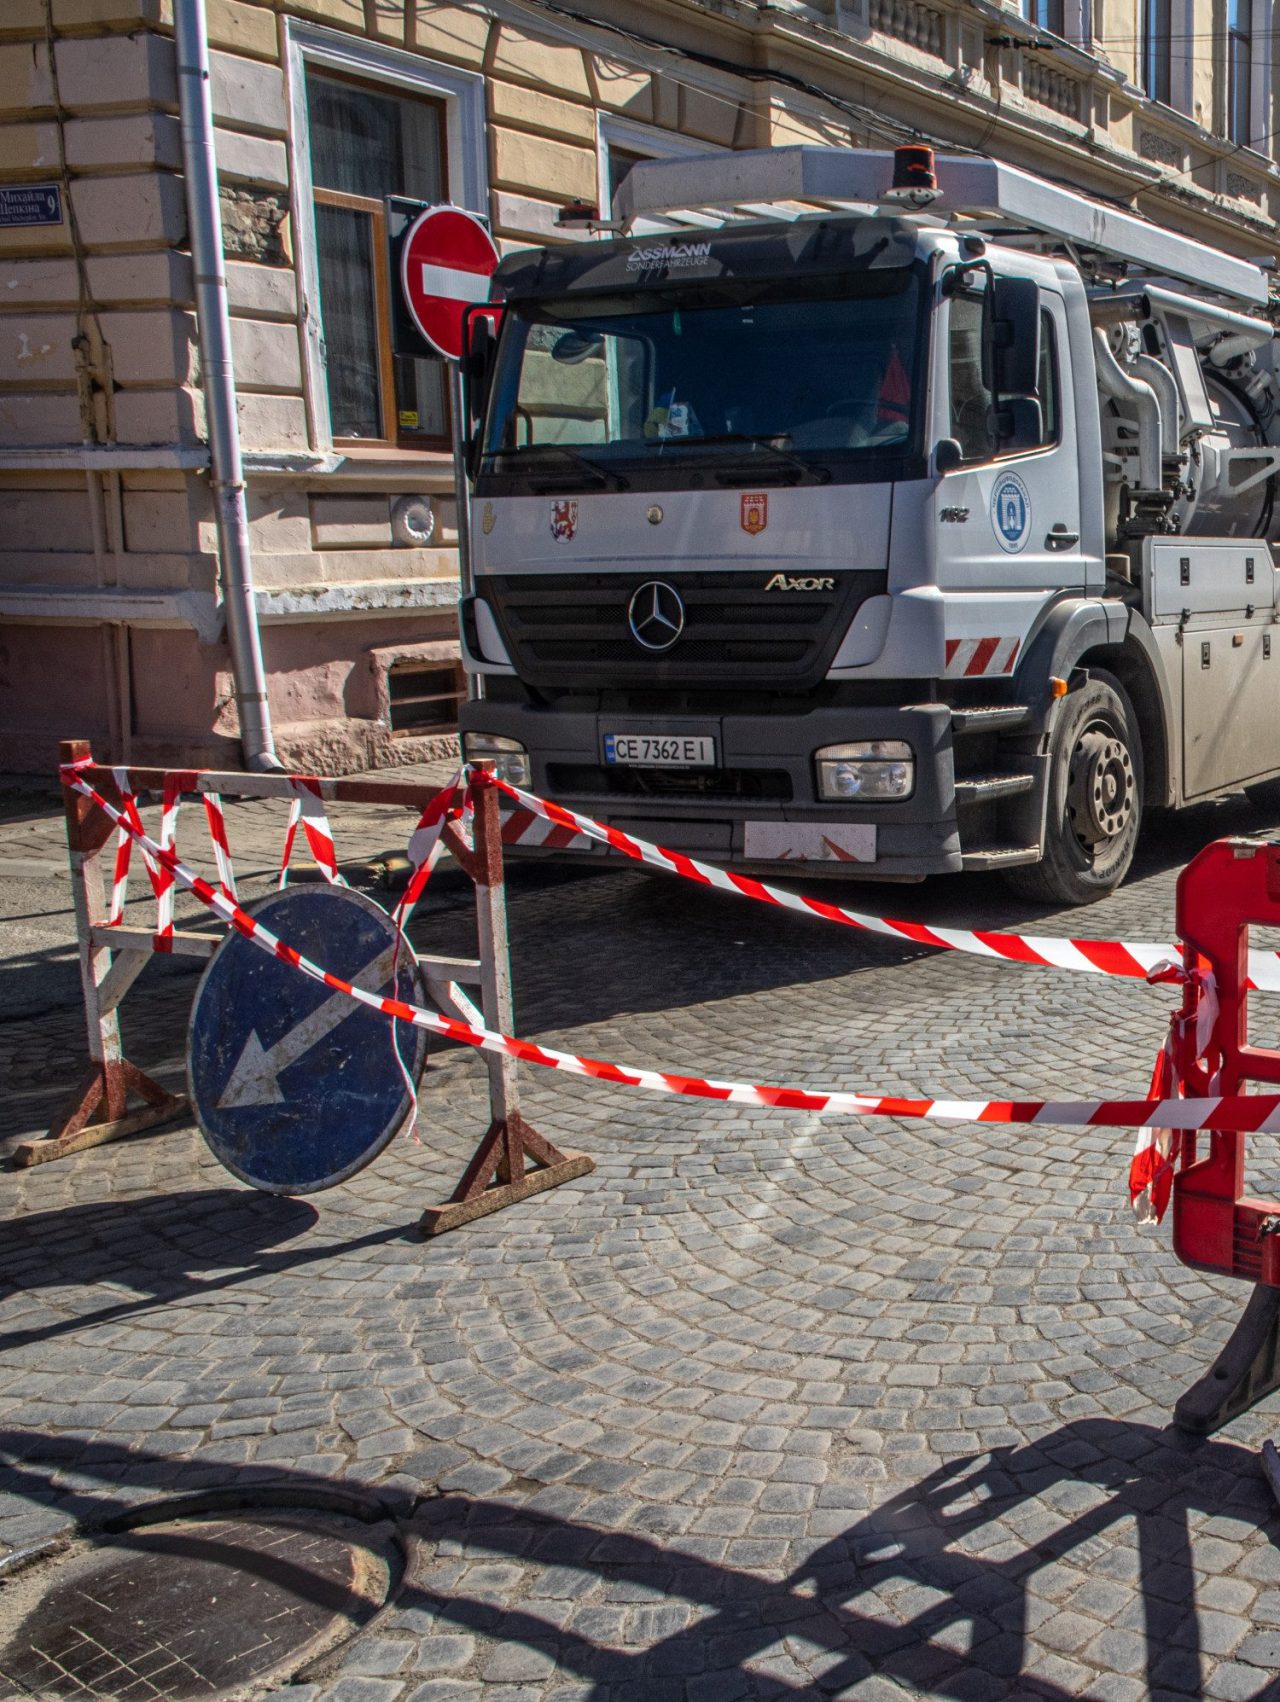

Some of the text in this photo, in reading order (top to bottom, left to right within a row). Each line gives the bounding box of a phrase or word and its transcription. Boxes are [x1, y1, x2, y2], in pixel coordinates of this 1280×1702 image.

[47, 194, 56, 215] 9
[628, 243, 711, 262] ASSMANN
[625, 256, 709, 272] SONDERFAHRZEUGE
[616, 740, 704, 760] CE 7362 EI
